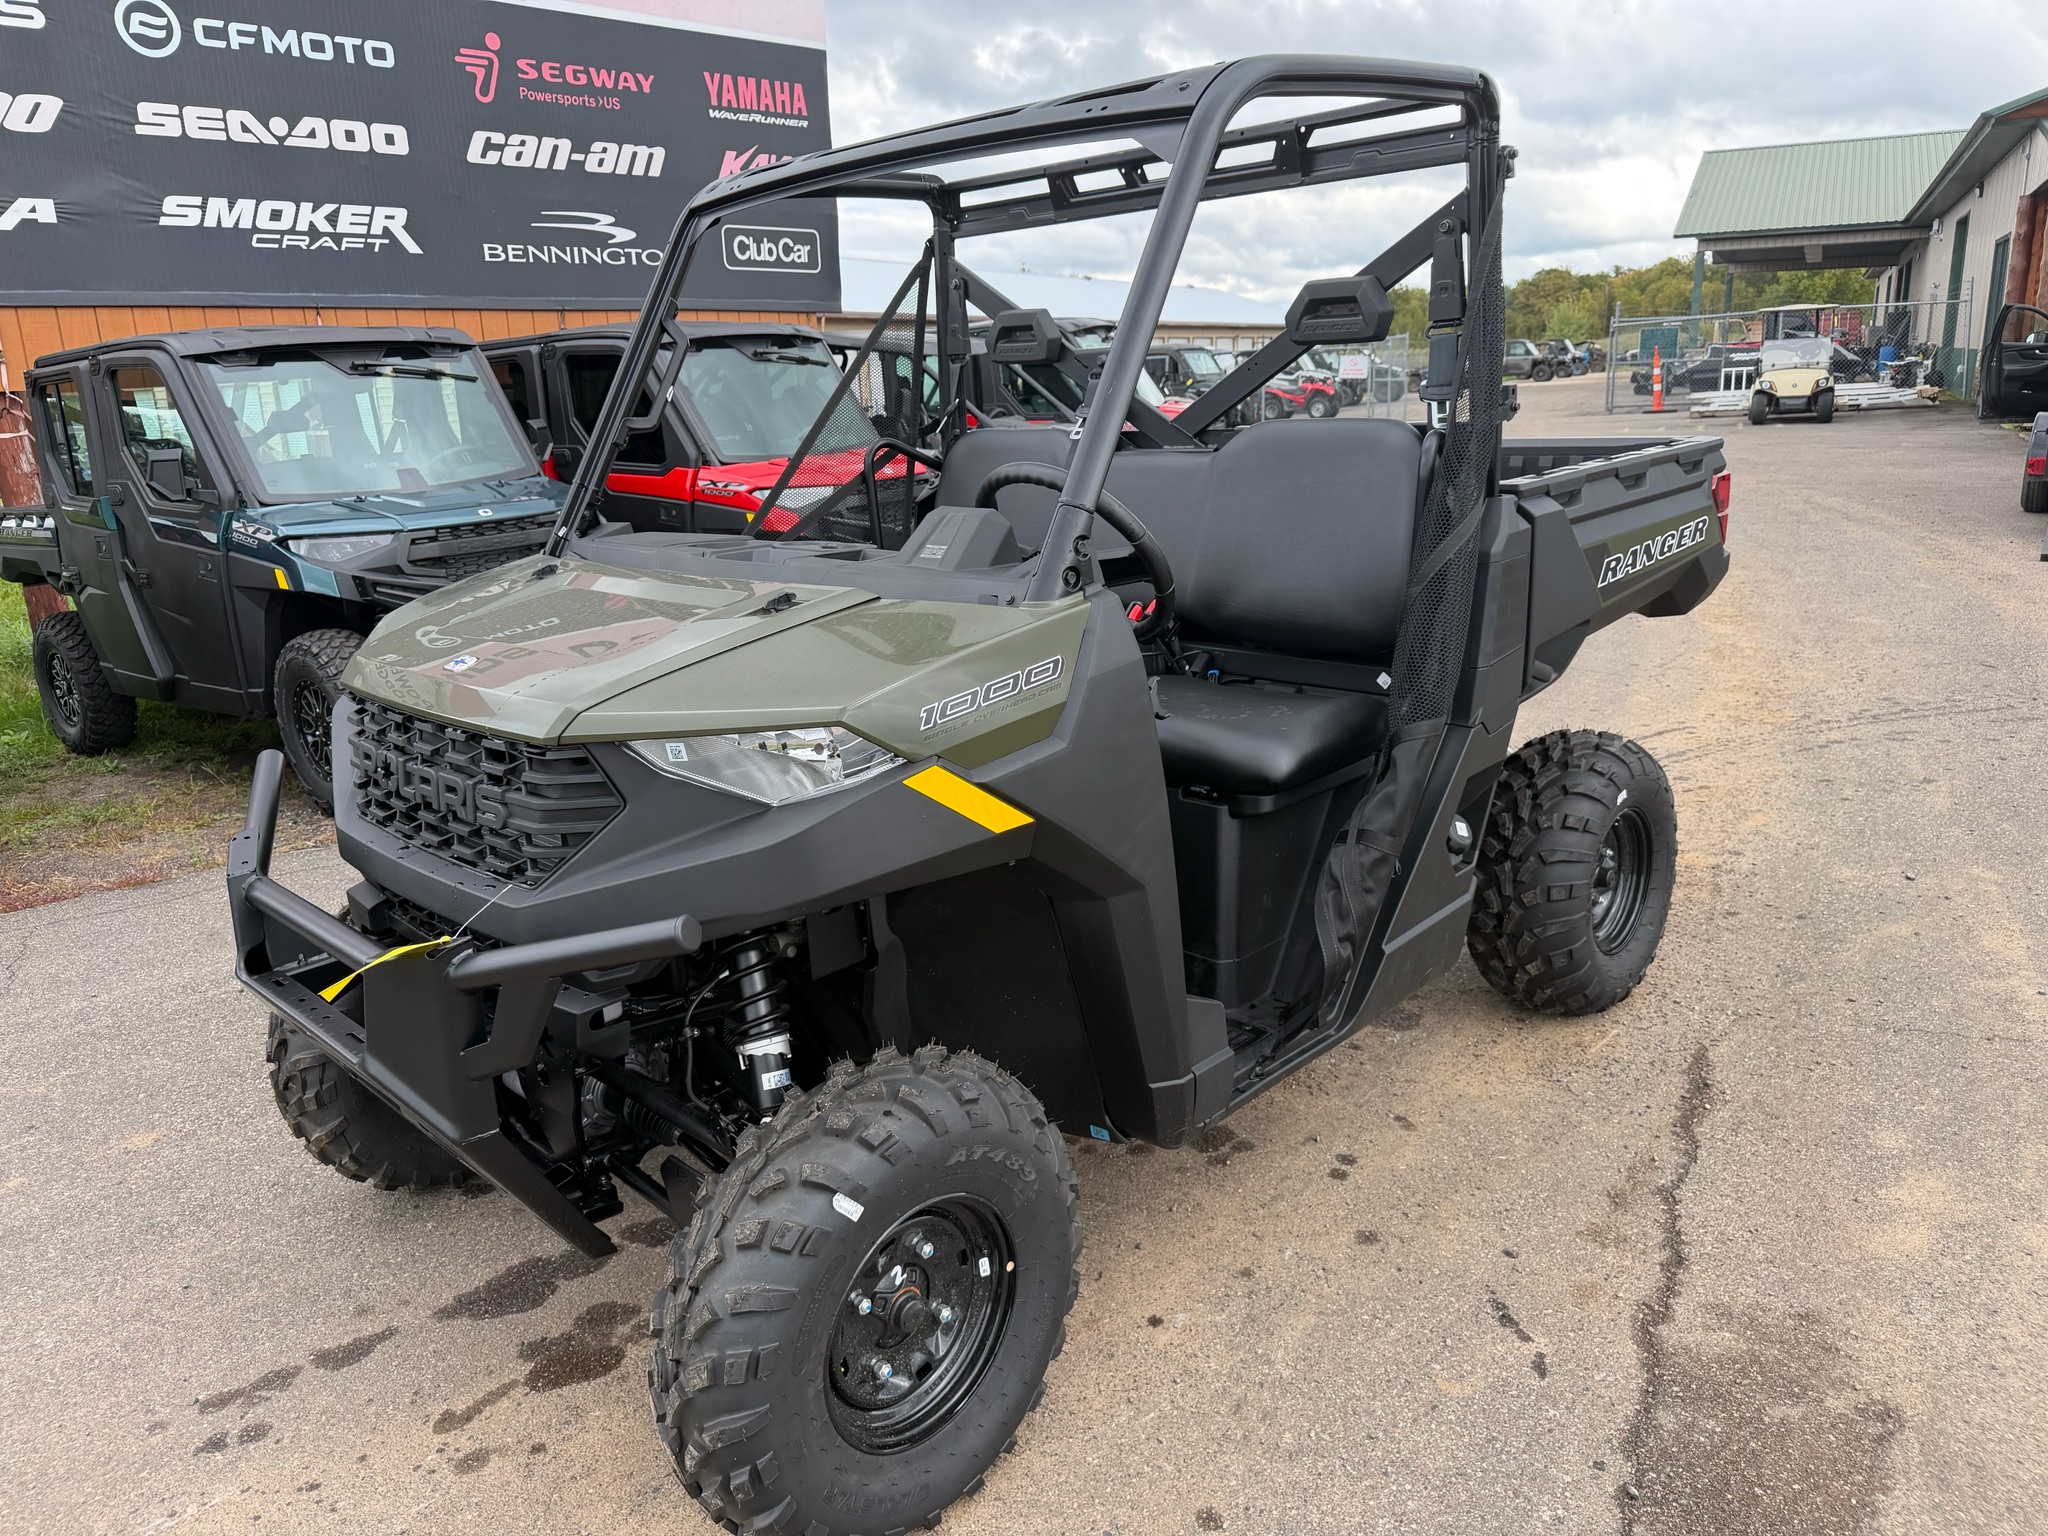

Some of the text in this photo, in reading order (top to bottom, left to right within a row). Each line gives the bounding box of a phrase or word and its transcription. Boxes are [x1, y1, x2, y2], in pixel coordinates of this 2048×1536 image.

[193, 17, 395, 68] CFMOTO
[516, 58, 655, 94] SEGWAY
[703, 71, 808, 116] YAMAHA
[158, 195, 424, 254] SMOKER
[252, 233, 390, 253] CRAFT
[482, 243, 664, 266] BENNINGTO
[231, 531, 259, 546] 1000
[1598, 516, 1708, 588] RANGER
[920, 655, 1066, 731] 1000
[357, 738, 511, 830] POLARIS
[944, 1144, 1037, 1181] AT489
